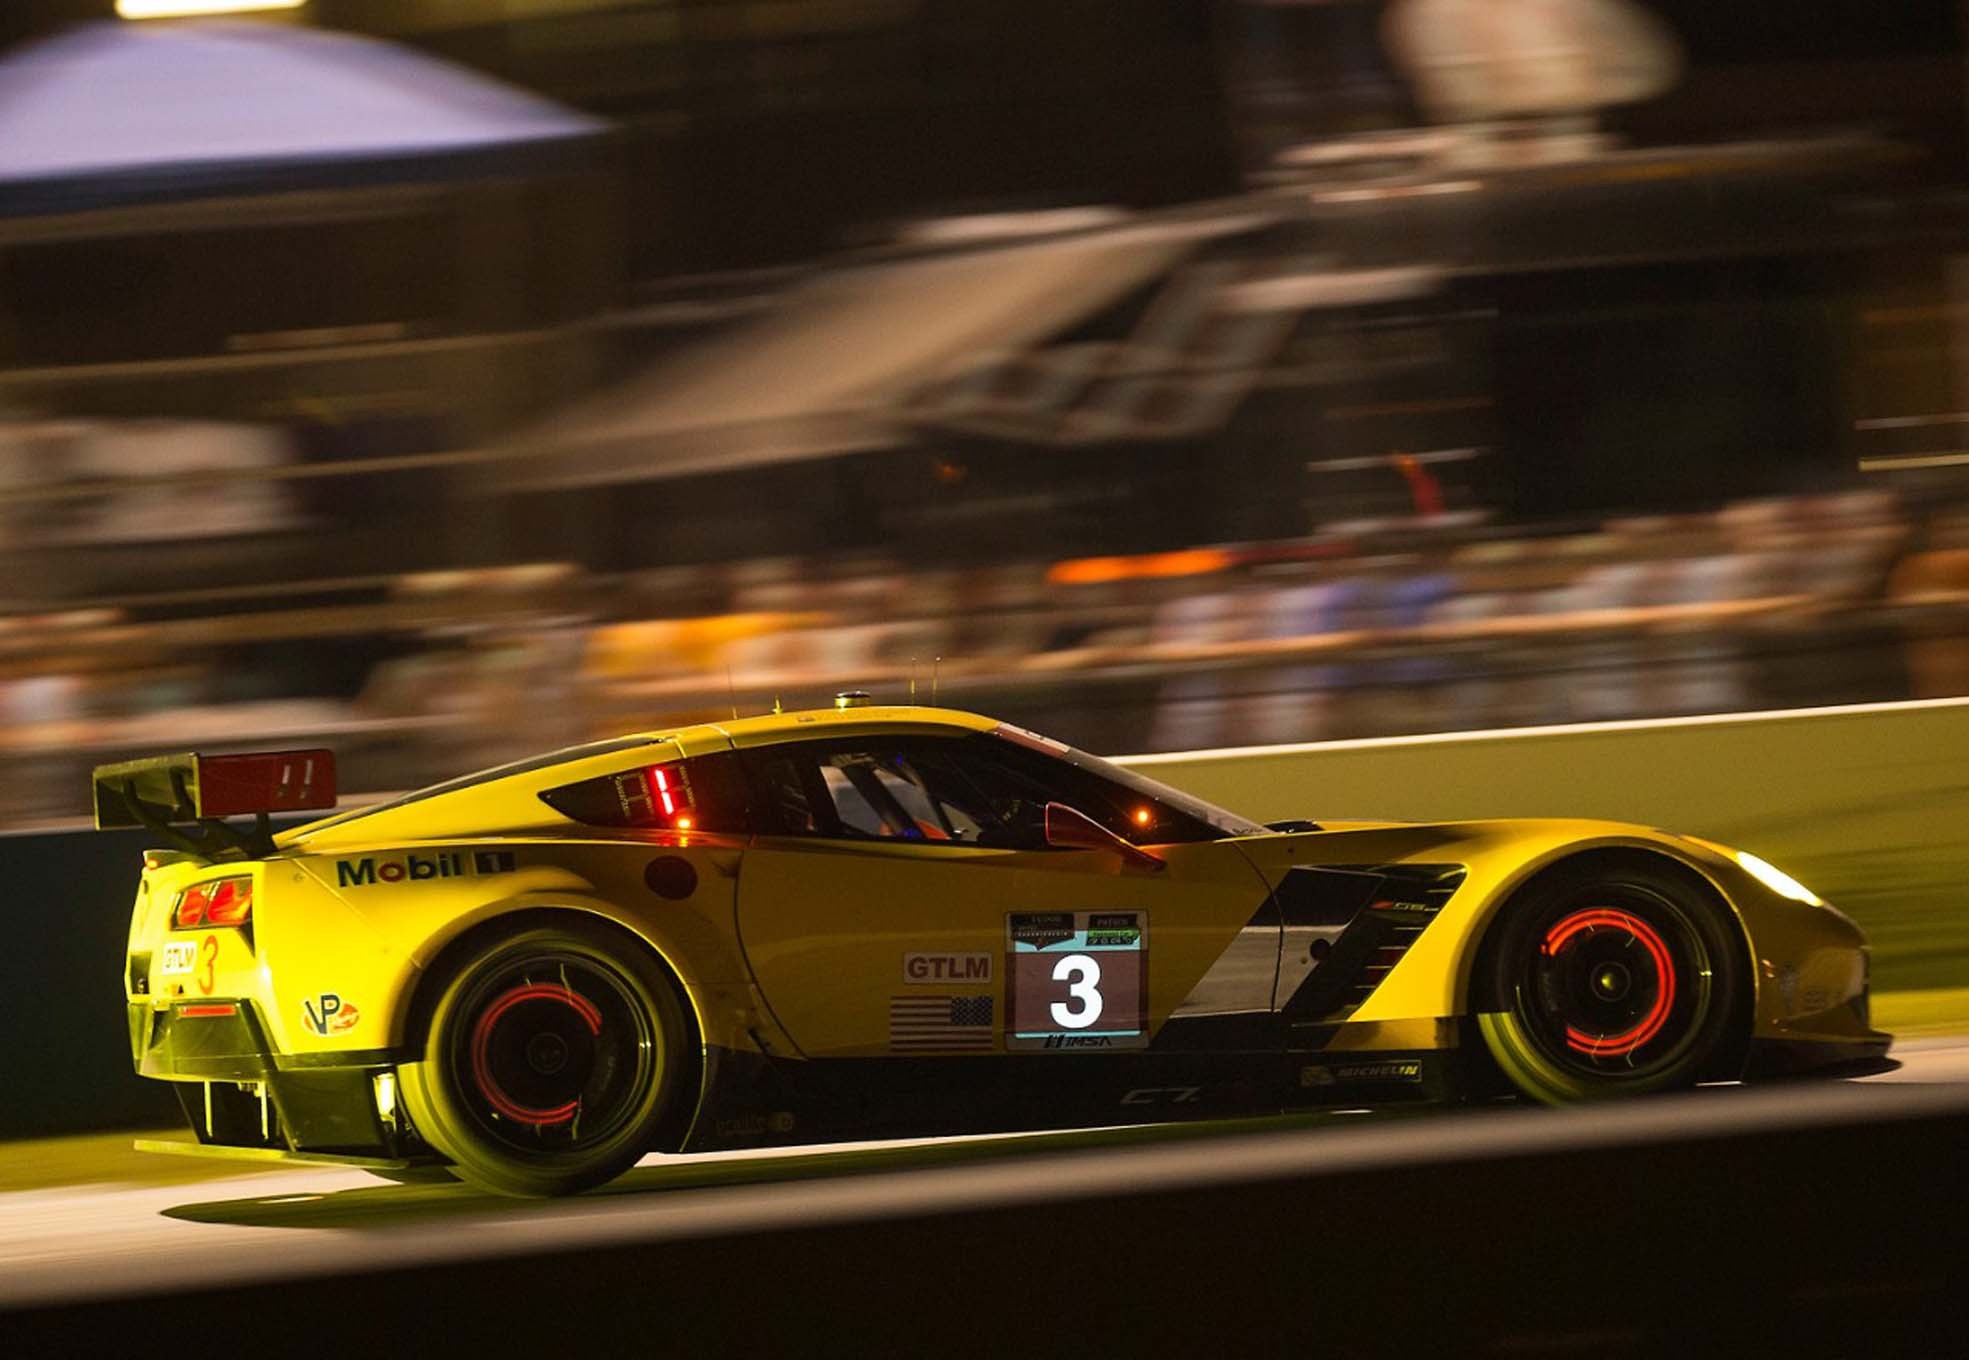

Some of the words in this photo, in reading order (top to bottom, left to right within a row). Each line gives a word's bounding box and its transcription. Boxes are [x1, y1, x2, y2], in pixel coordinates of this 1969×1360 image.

[336, 851, 463, 888] Mobil
[198, 934, 219, 996] 3
[907, 956, 989, 979] GTLM
[1049, 953, 1104, 1030] 3
[305, 994, 341, 1035] VP
[1065, 1036, 1113, 1048] IMSA
[1337, 1063, 1419, 1078] MICHELIN
